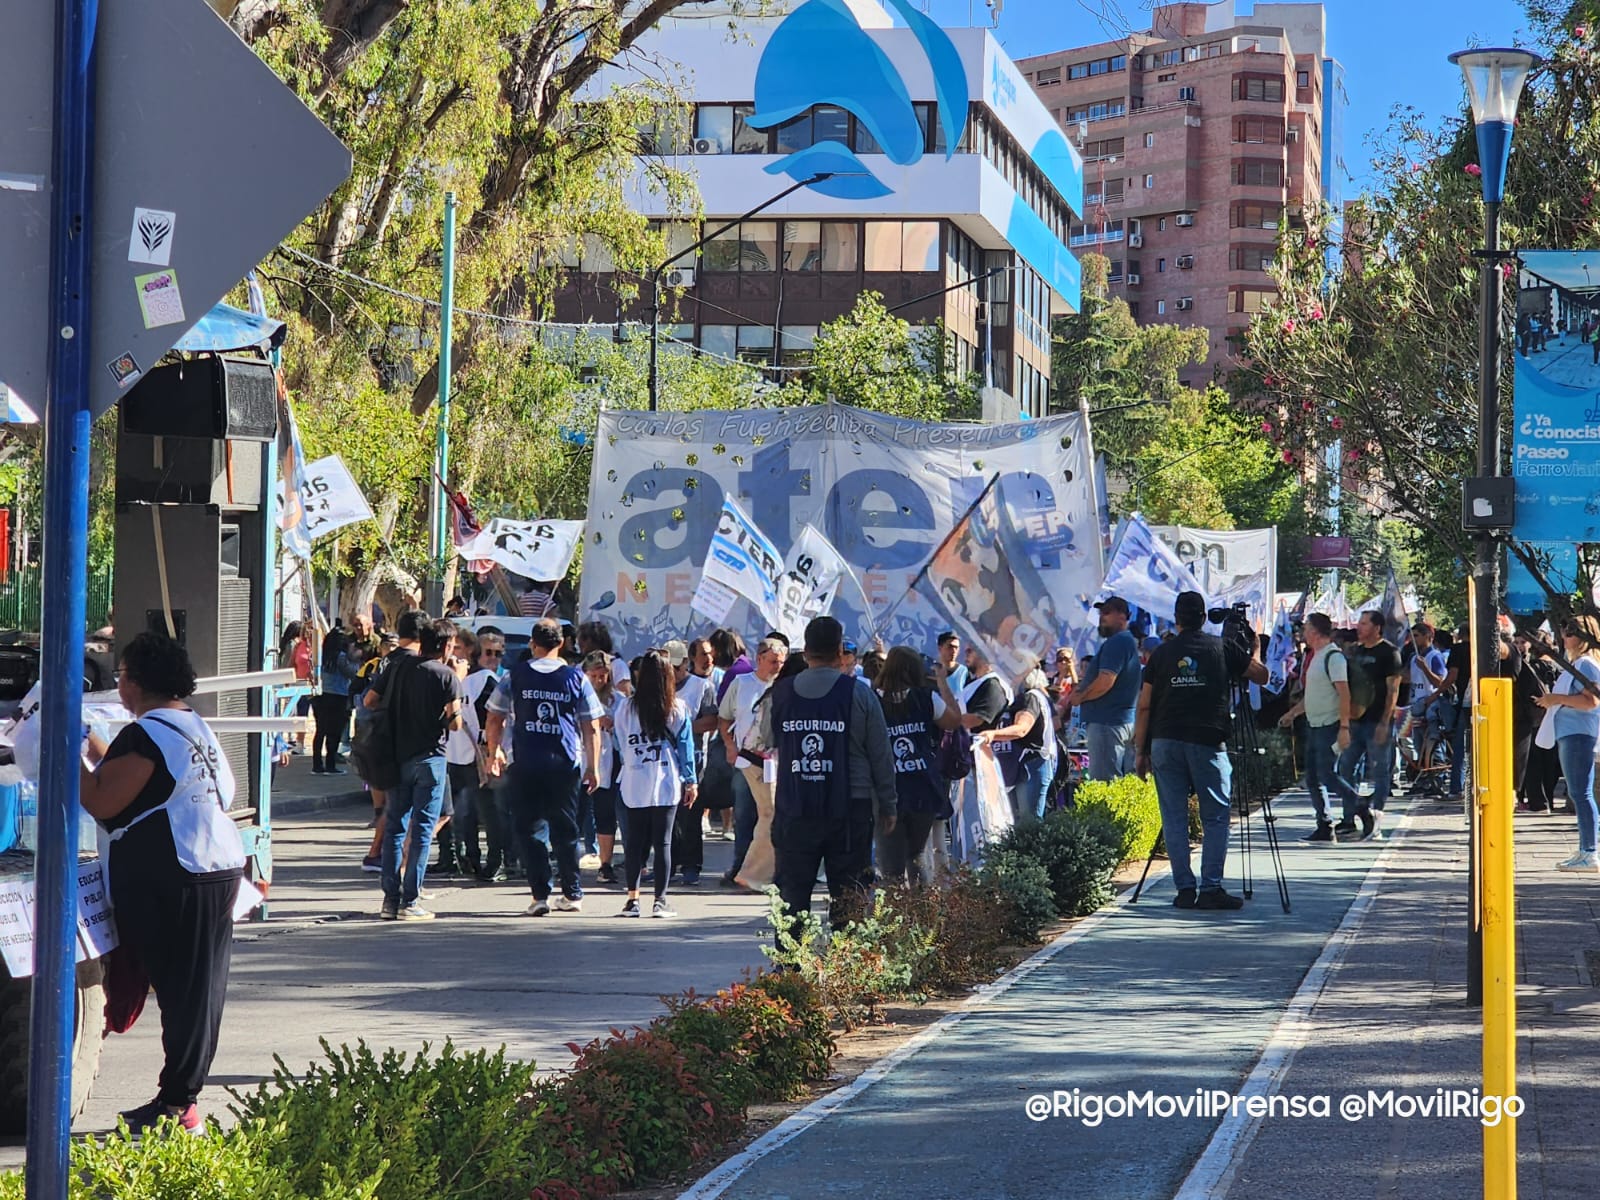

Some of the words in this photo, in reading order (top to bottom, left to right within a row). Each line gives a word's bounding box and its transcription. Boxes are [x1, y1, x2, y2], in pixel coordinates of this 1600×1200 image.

[617, 412, 704, 437] Carlos
[719, 412, 877, 438] Fuentealba
[1517, 444, 1569, 459] Paseo
[1170, 676, 1199, 684] CANAL
[521, 689, 571, 703] SEGURIDAD
[525, 719, 561, 735] aten
[782, 719, 845, 732] SEGURIDAD
[791, 756, 833, 773] aten
